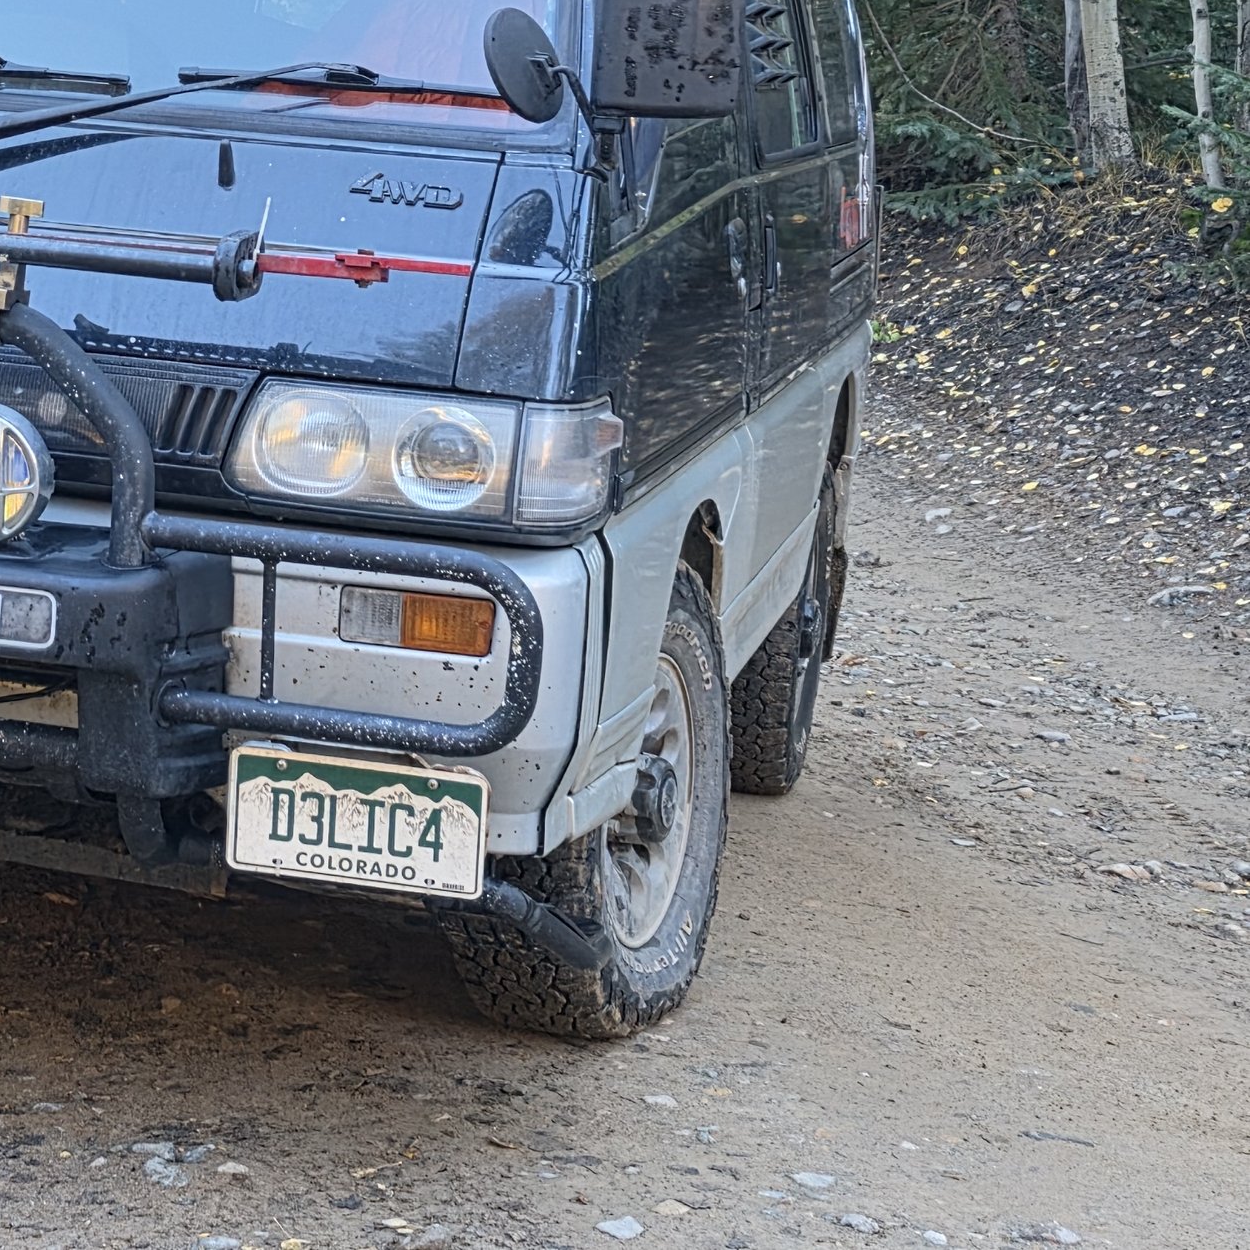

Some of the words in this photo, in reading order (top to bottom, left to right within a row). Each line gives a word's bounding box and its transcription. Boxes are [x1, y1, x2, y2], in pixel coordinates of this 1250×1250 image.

[349, 172, 465, 211] 4WD
[268, 786, 444, 863] D3LIC4
[295, 851, 417, 881] COLORADO
